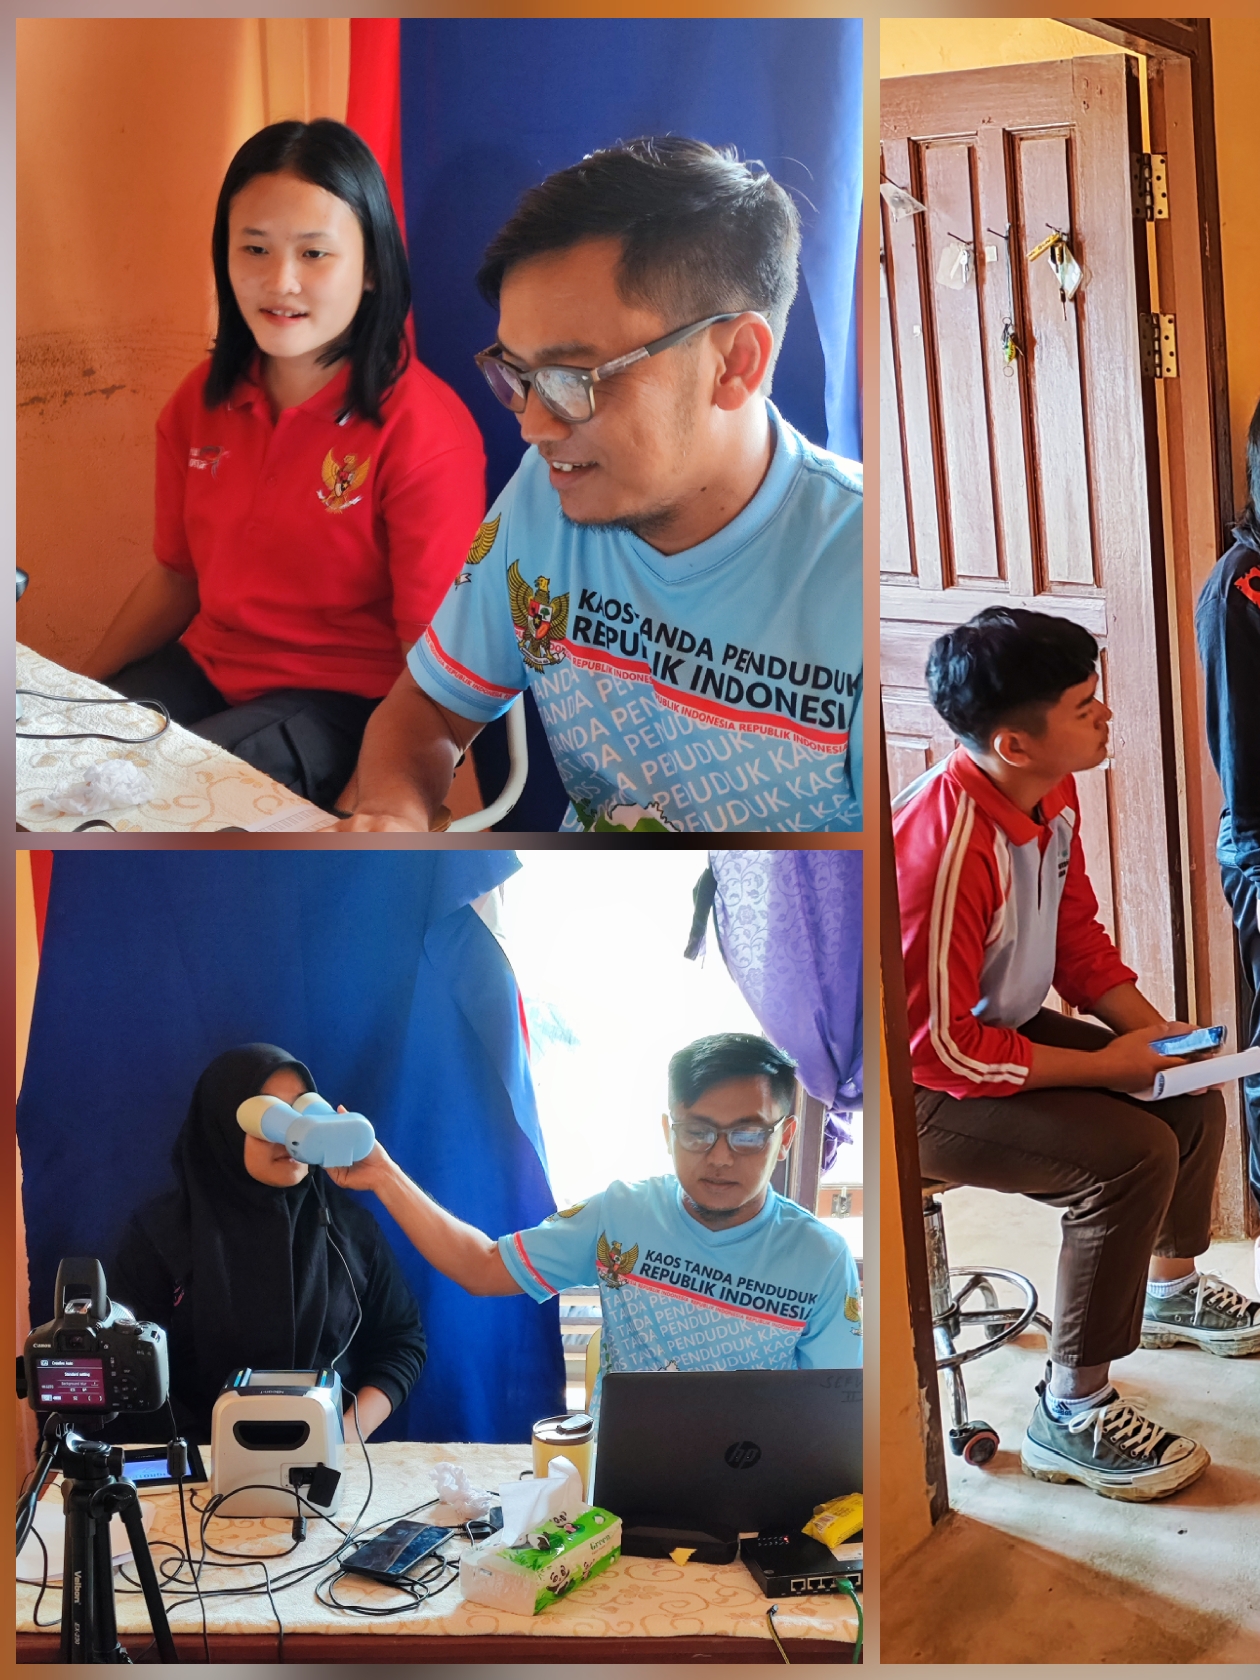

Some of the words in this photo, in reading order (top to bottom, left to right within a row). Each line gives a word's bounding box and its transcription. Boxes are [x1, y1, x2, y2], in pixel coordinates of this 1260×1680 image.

[578, 588, 634, 625] KAOS
[634, 609, 714, 662] ANDA
[721, 642, 861, 697] PENDUDUK
[444, 663, 475, 687] REPUBLIK
[533, 667, 580, 702] ANDA
[539, 689, 594, 728] ANDA
[572, 656, 613, 676] REPUBLIK
[613, 668, 653, 684] INDONES
[680, 705, 736, 732] INDONESIA
[738, 722, 791, 741] REPUBLIK
[792, 733, 849, 755] INDONESIA
[689, 664, 850, 731] INDONESI
[549, 717, 611, 757] ANDA
[785, 761, 846, 800] KAO
[639, 1262, 717, 1298] REPUBLIK
[645, 1249, 682, 1269] KAOS
[685, 1259, 732, 1286] TANDA
[736, 1276, 819, 1305] PENDUDUK
[659, 1310, 731, 1337] PENDUD
[667, 1319, 752, 1352] PENDUDUK
[672, 1334, 757, 1366] PENDUDUK
[725, 1440, 762, 1470] hp
[74, 1570, 82, 1604] Velbon
